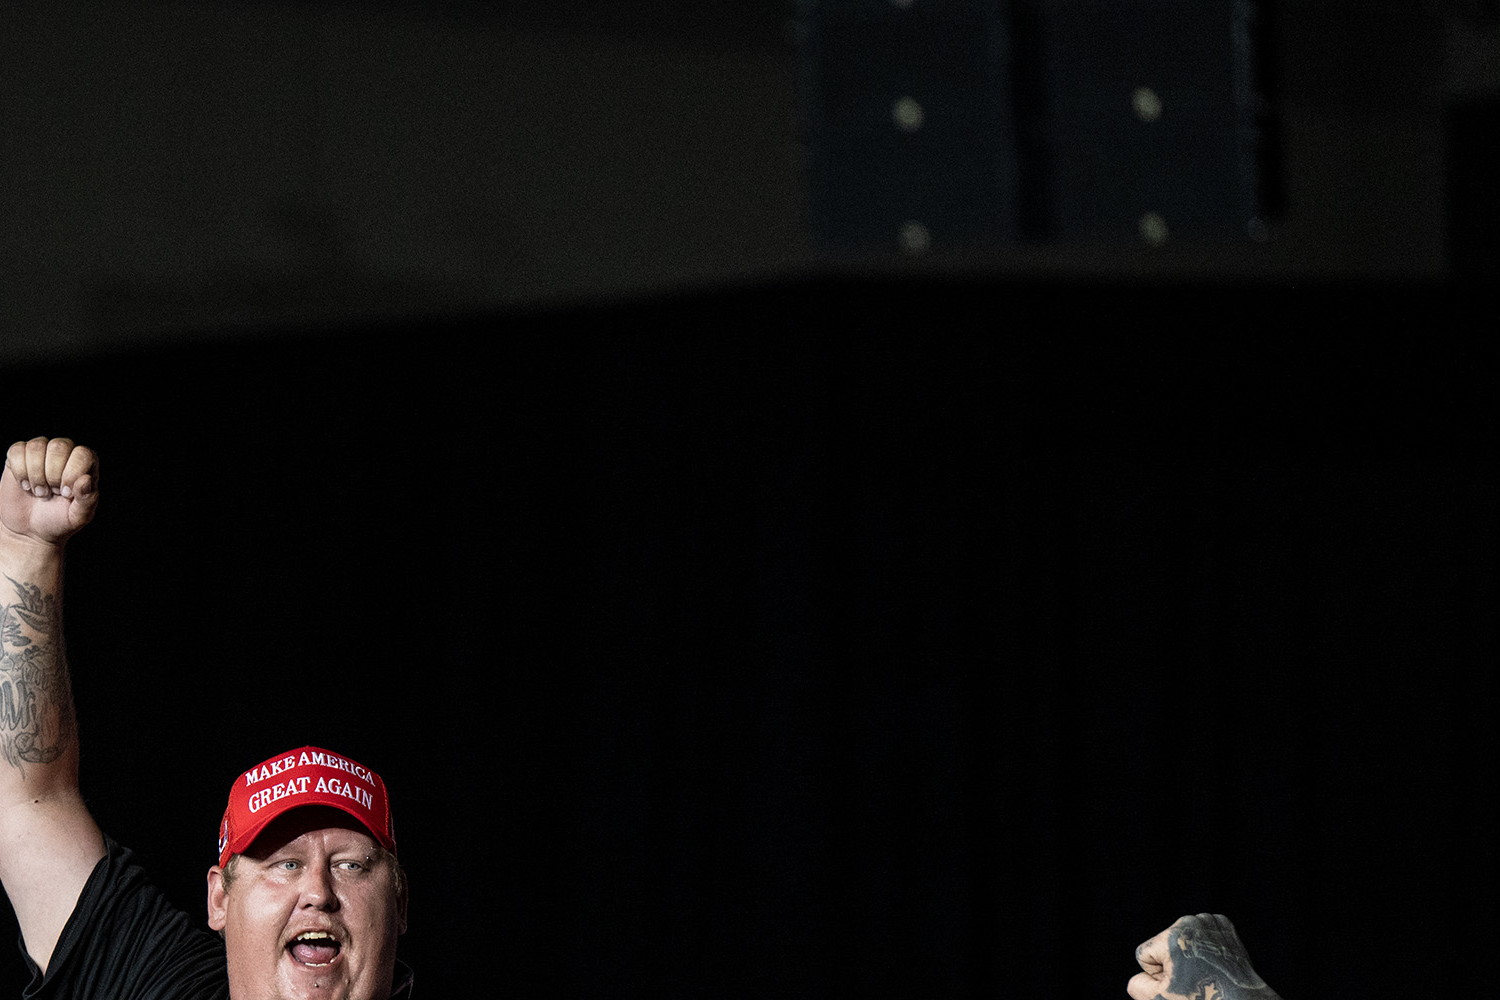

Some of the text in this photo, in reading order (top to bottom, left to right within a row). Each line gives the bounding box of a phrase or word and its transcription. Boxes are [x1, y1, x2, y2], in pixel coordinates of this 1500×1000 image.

[244, 751, 377, 788] MAKE AMERICA
[248, 776, 374, 814] GREAT AGAIN
